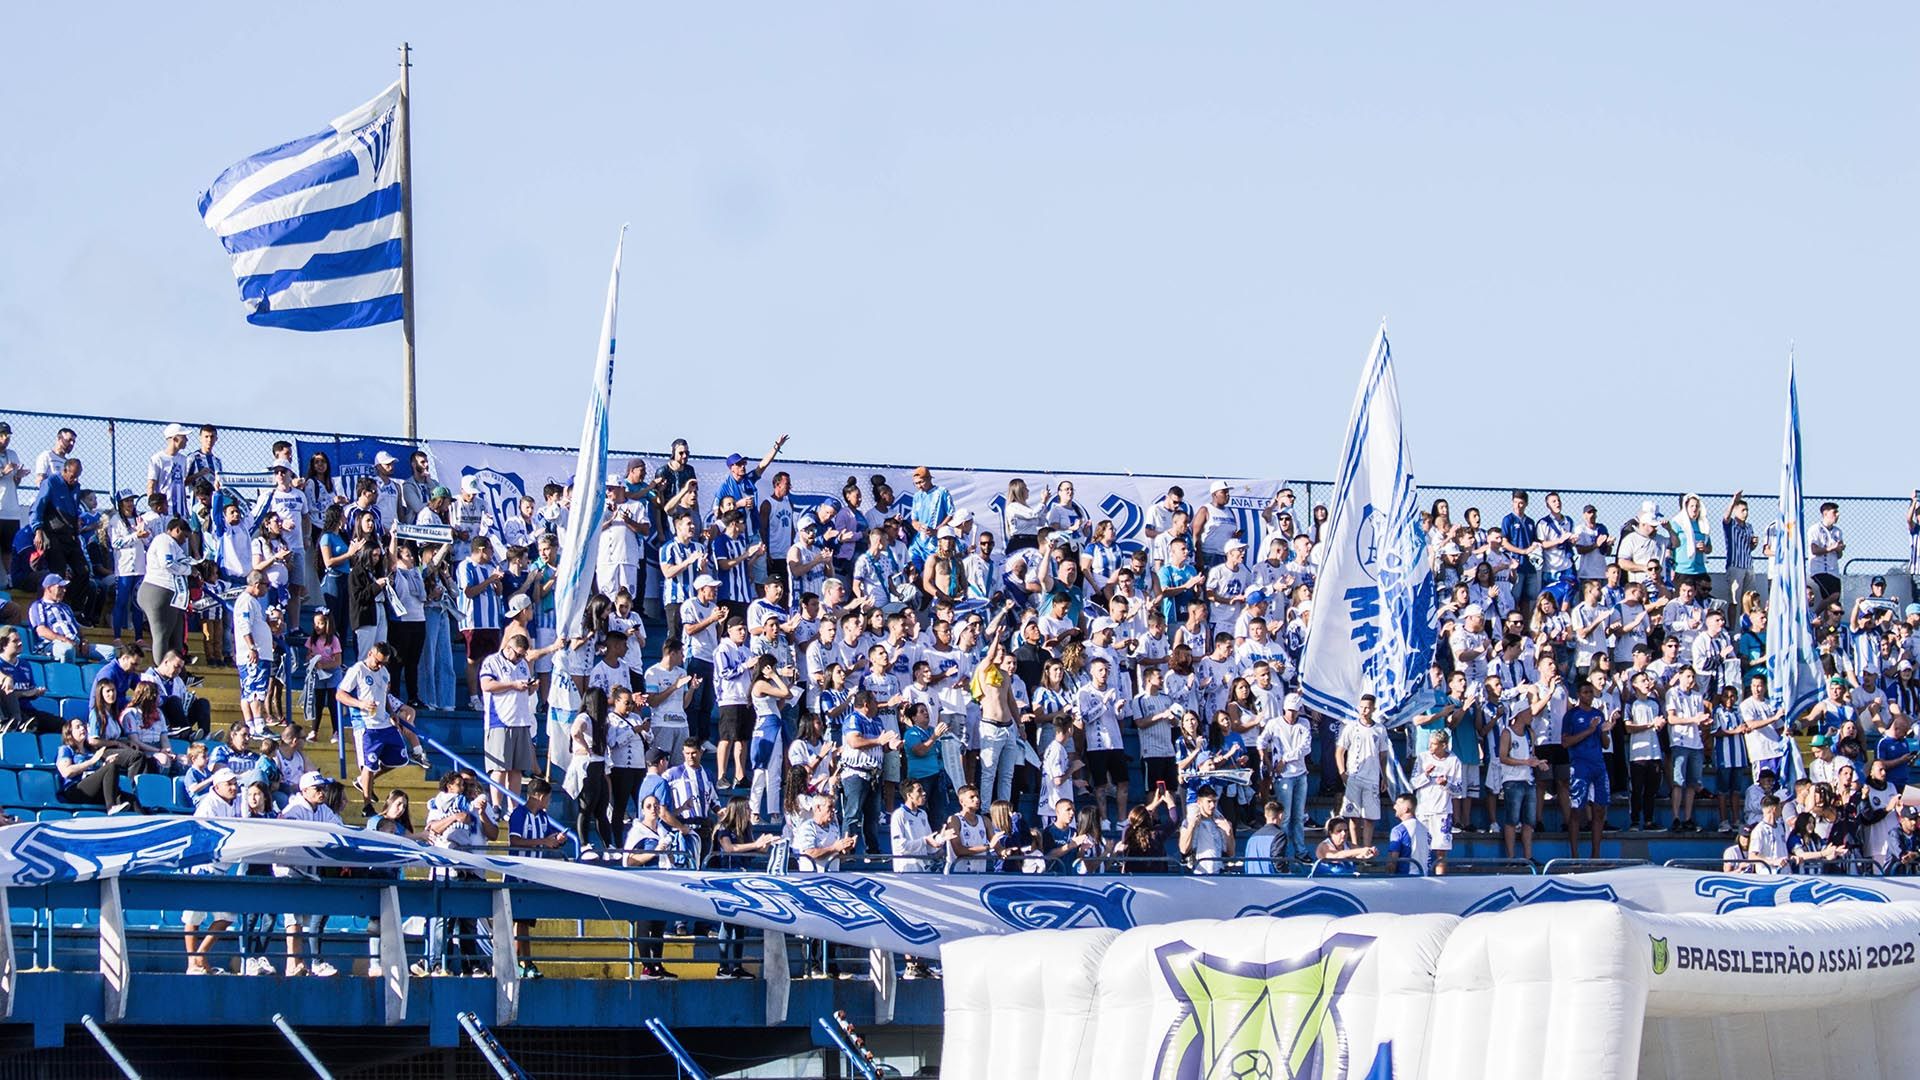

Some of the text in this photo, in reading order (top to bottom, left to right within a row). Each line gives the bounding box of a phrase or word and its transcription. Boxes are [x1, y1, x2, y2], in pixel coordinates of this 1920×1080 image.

[1677, 942, 1915, 974] BRASILEIRÃO ASSAÍ 2022
